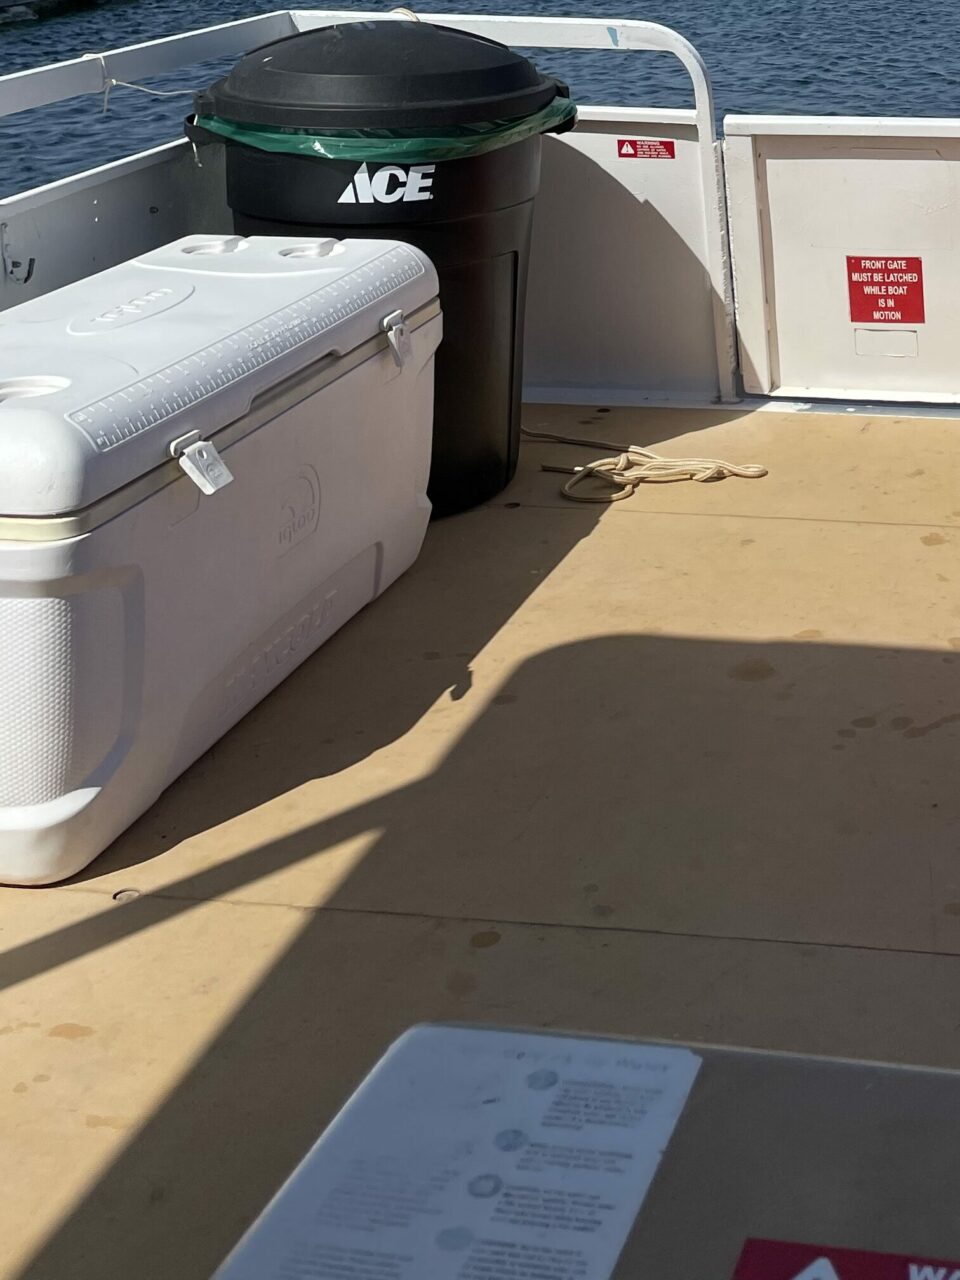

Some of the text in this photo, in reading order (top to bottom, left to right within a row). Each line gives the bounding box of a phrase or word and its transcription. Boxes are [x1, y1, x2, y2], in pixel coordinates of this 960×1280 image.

[337, 161, 435, 204] ACE
[861, 260, 907, 270] FRONT GATE
[851, 272, 918, 282] MUST BE LATCHED
[863, 285, 908, 295] WHILE BOAT
[878, 298, 895, 308] IS IN
[873, 310, 901, 320] MOTION
